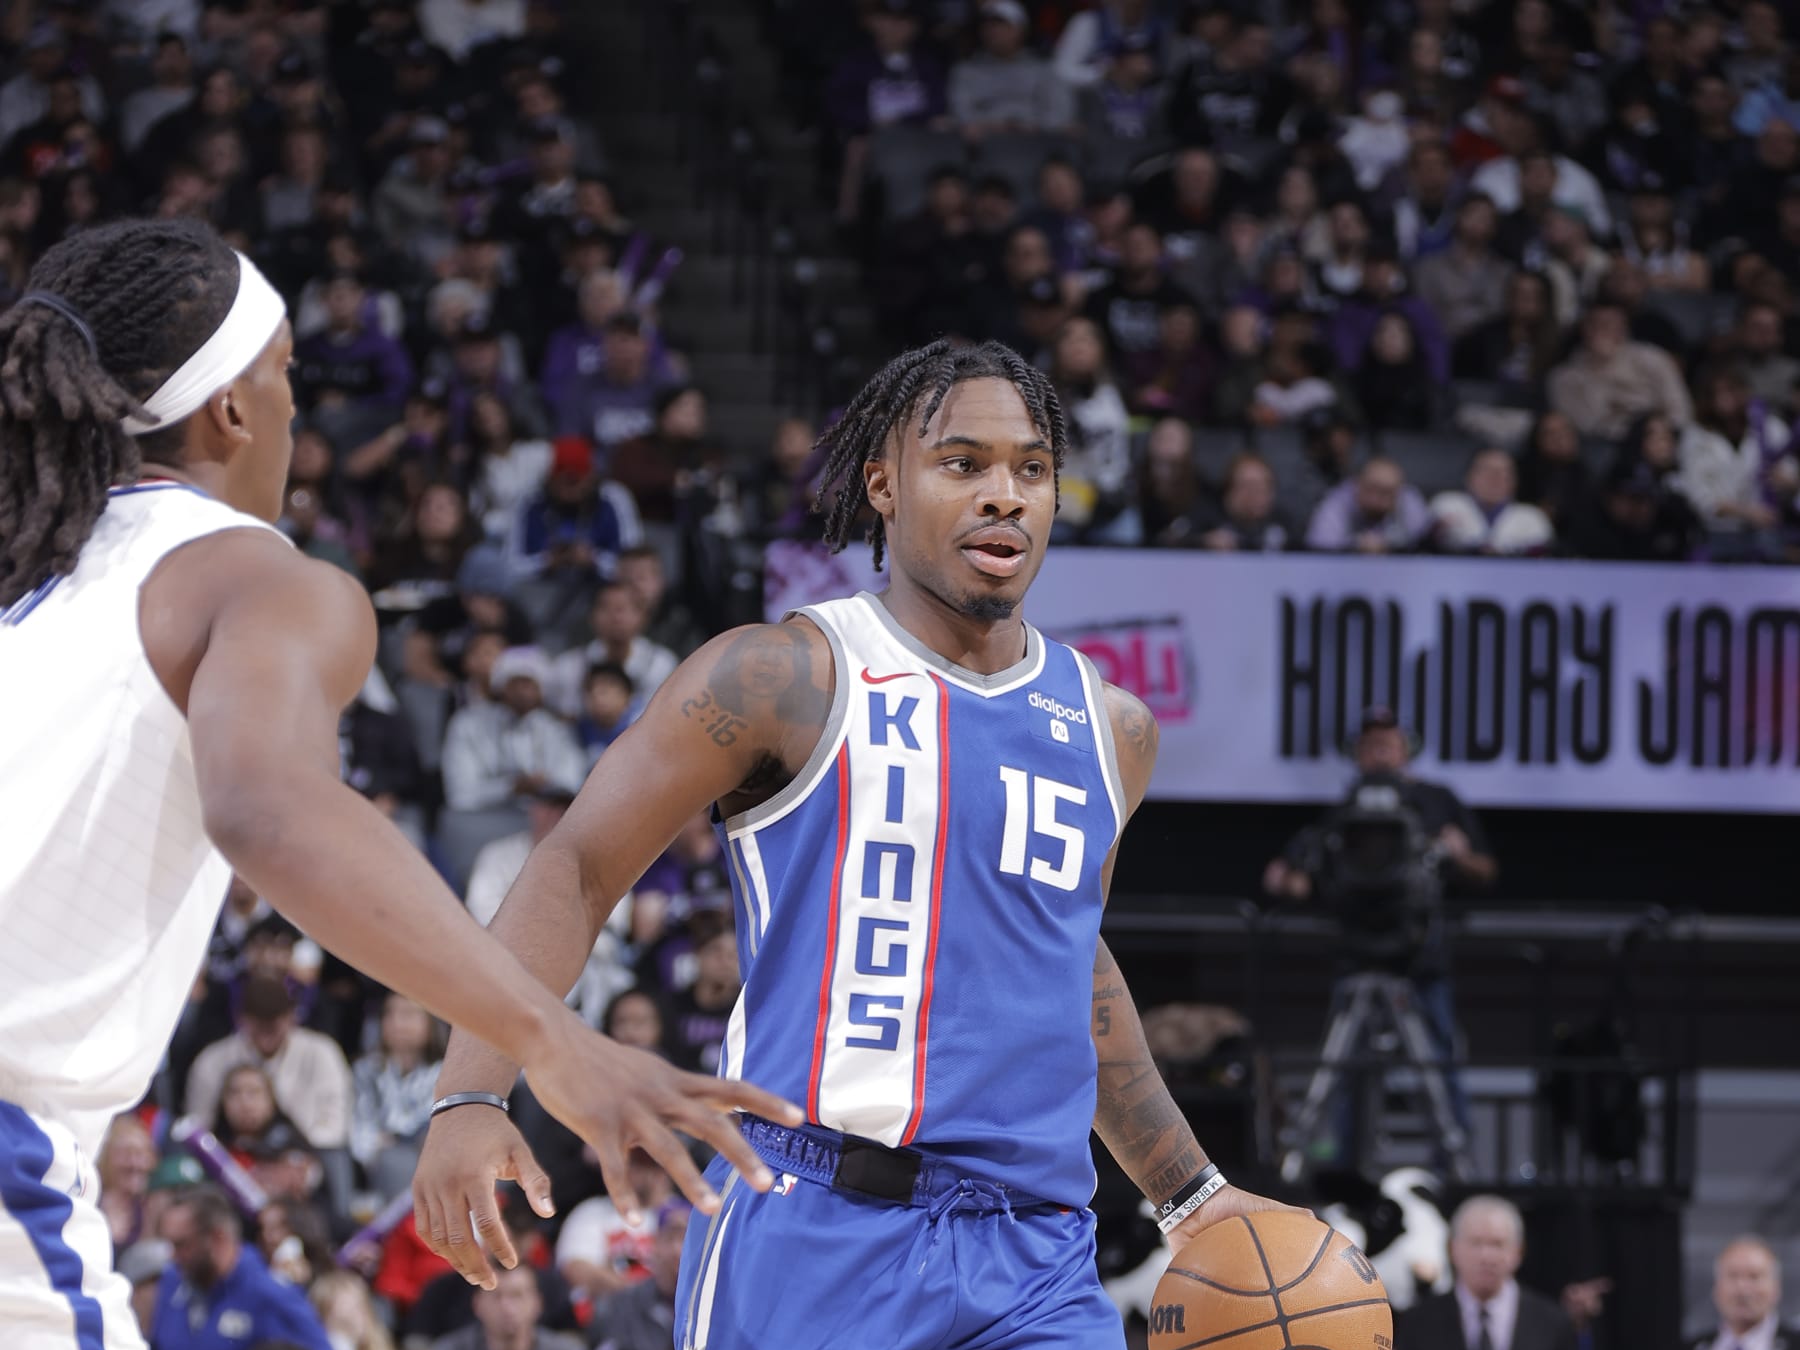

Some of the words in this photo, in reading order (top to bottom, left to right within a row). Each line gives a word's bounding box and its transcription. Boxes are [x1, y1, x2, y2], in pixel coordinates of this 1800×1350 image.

[1028, 691, 1088, 725] dialpad
[1279, 595, 1615, 766] HOLIDAY
[845, 691, 922, 1051] KINGS
[999, 765, 1087, 891] 15
[1160, 1199, 1176, 1217] JOY
